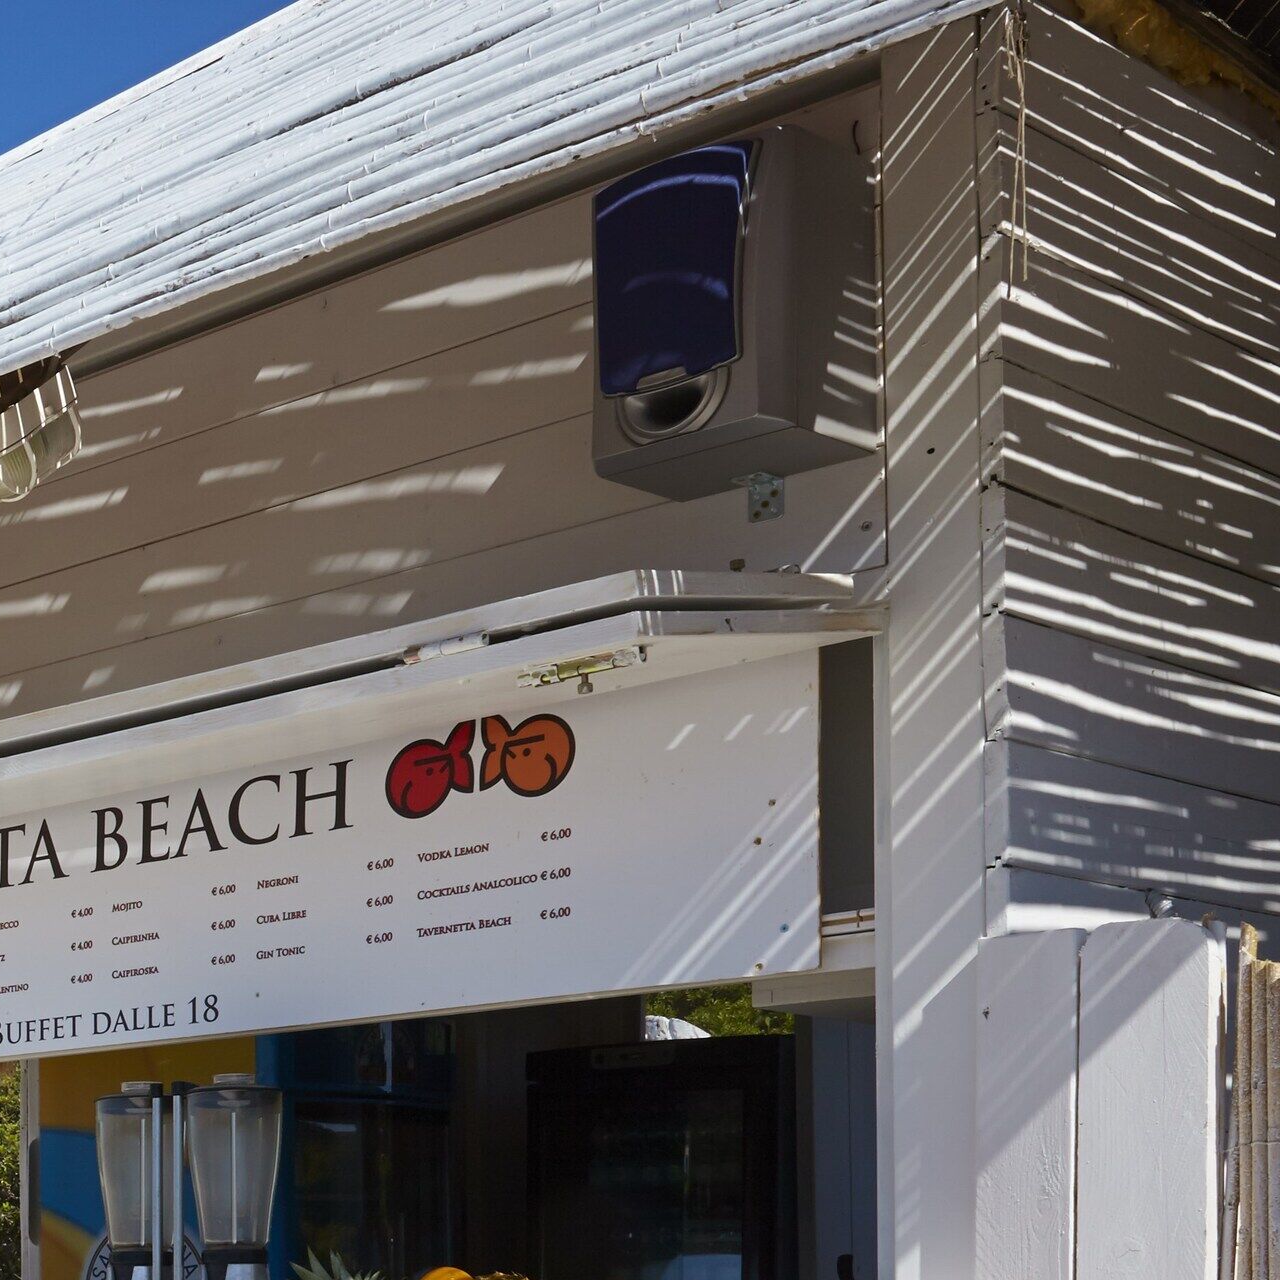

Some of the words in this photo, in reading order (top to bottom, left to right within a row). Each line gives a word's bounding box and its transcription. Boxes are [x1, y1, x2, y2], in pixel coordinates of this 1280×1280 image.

[91, 758, 354, 874] BEACH
[417, 850, 452, 863] VODKA
[454, 843, 490, 857] LEMON
[550, 827, 571, 841] 6,00
[256, 875, 299, 890] NEGRONI
[375, 857, 394, 870] 6,00
[417, 884, 471, 900] COCKTAILS
[472, 874, 538, 892] ANALCOLICO
[549, 867, 571, 880] 6,00
[77, 907, 93, 917] 4,00
[111, 900, 143, 913] MOJITO
[218, 884, 236, 895] 6,00
[256, 914, 281, 925] CUBA
[282, 910, 307, 921] LIBRE
[374, 894, 394, 906] 6,00
[111, 932, 160, 946] CAIPIRINHA
[218, 918, 236, 930] 6,00
[416, 922, 476, 938] TAVERNETTA
[478, 916, 511, 929] BEACH
[549, 906, 571, 919] 6,00
[77, 940, 93, 950] 4,00
[256, 950, 274, 960] GIN
[276, 945, 306, 958] TONIC
[374, 931, 393, 943] 6,00
[77, 973, 93, 983] 4,00
[111, 966, 159, 979] CAIPIROSKA
[218, 953, 236, 965] 6,00
[92, 1003, 176, 1035] DALLE
[187, 994, 219, 1024] 18
